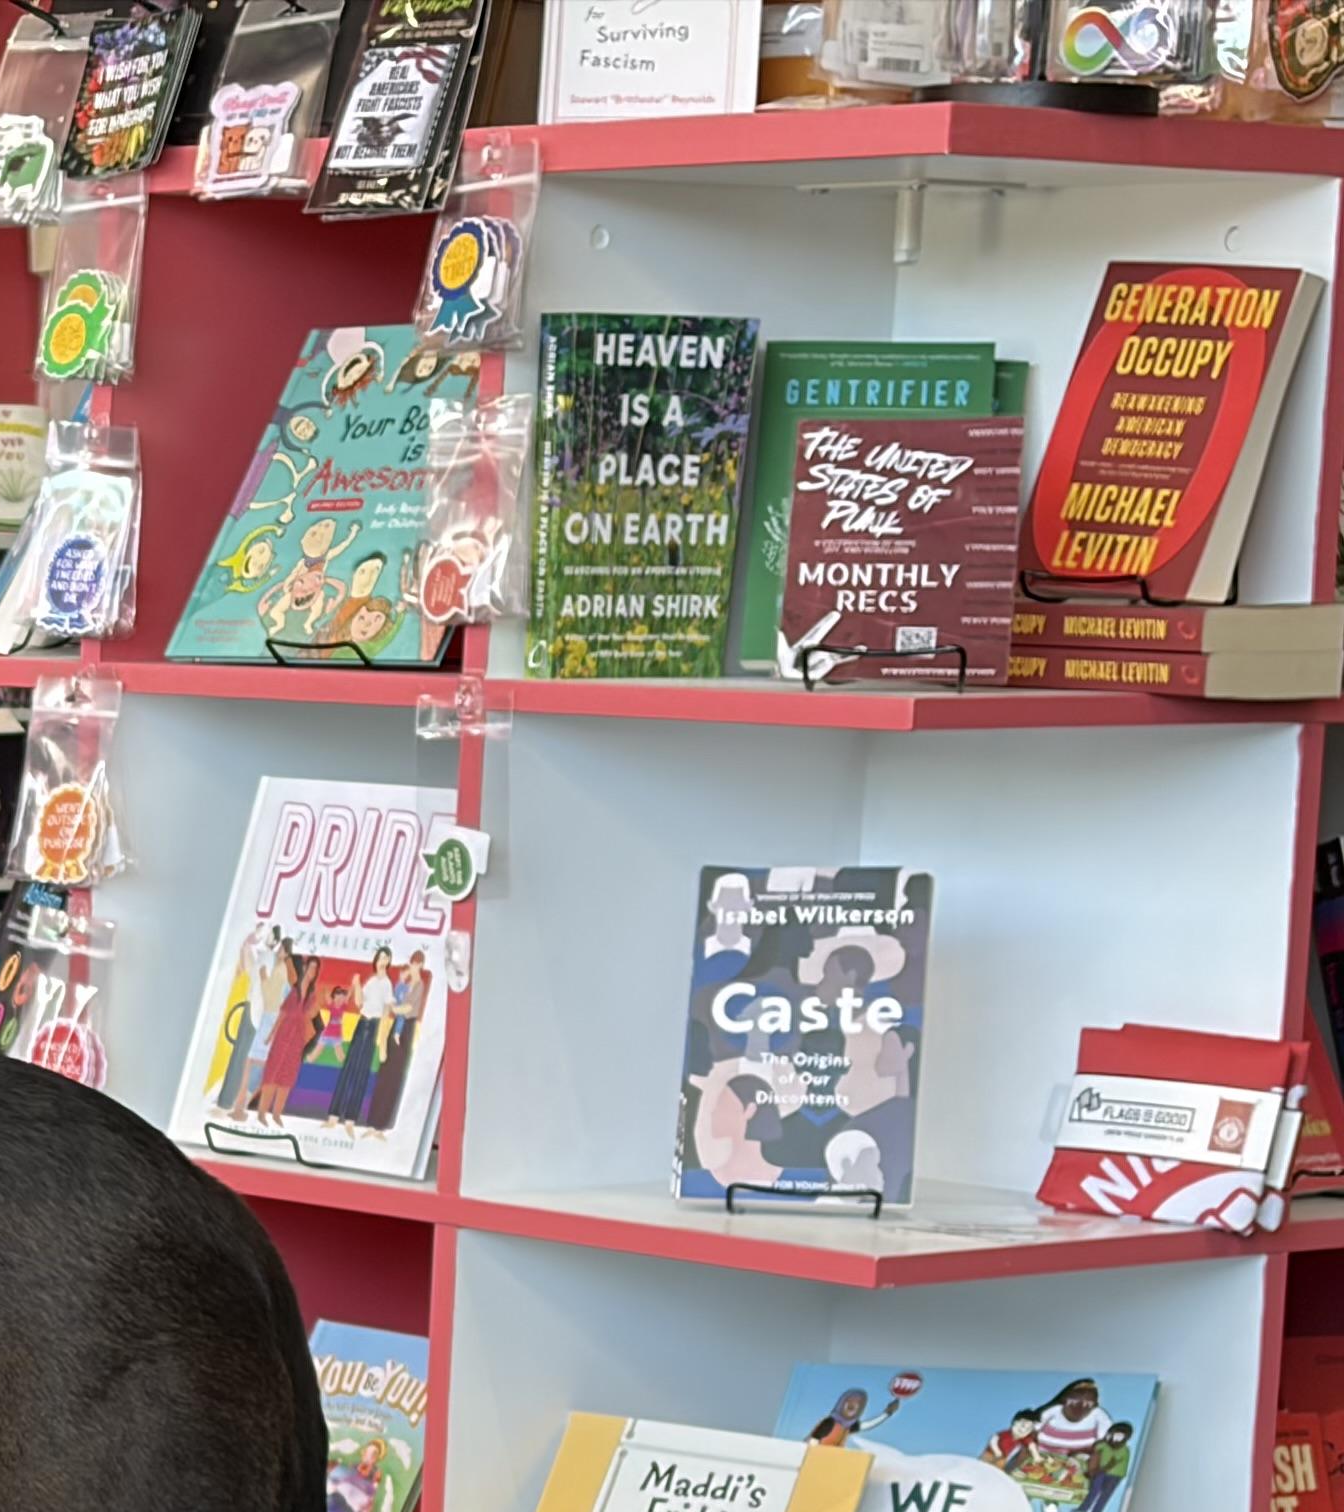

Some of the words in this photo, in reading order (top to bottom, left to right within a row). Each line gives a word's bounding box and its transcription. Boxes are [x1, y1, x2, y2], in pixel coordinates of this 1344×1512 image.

[584, 6, 606, 22] for
[597, 23, 690, 44] Surviving
[105, 60, 132, 82] WISH
[132, 55, 151, 74] FOR
[150, 48, 170, 69] YOU
[579, 50, 656, 73] Fascism
[94, 87, 121, 110] WHAT
[123, 82, 141, 103] YOU
[368, 81, 421, 97] AMERICANS
[354, 98, 382, 113] FIGHT
[1103, 282, 1283, 331] GENERATION
[594, 332, 726, 370] HEAVEN
[1115, 336, 1234, 380] OCCUPY
[785, 378, 972, 407] GENTRIFIER
[1110, 391, 1207, 416] REAWAKENING
[620, 393, 650, 426] IS
[661, 394, 685, 427] A
[339, 414, 389, 443] Your
[1113, 415, 1187, 438] AMERICAN
[401, 434, 426, 463] is
[802, 426, 864, 461] THE
[864, 442, 976, 485] UNITED
[1101, 439, 1185, 461] DEMOCRACY
[598, 454, 702, 487] PLACE
[796, 463, 910, 506] STATES
[908, 485, 953, 513] OF
[820, 499, 905, 540] PUNK
[1060, 481, 1183, 529] MICHAEL
[563, 511, 614, 546] ON
[623, 512, 731, 547] EARTH
[1051, 530, 1161, 576] LEVITIN
[797, 562, 962, 589] MONTHLY
[559, 593, 646, 619] ADRIAN
[651, 594, 721, 620] SHIRK
[835, 590, 919, 614] RECS
[1063, 615, 1117, 638] MICHAEL
[1118, 617, 1169, 641] LEVITIN
[1064, 658, 1119, 682] MICHAEL
[1120, 661, 1170, 684] LEVITIN
[255, 801, 459, 937] PRIDE
[716, 904, 788, 926] Isabel
[794, 904, 916, 927] Wilkerson
[710, 981, 904, 1036] Caste
[760, 1051, 790, 1067] The
[792, 1052, 852, 1072] Origins
[778, 1070, 796, 1085] of
[797, 1070, 832, 1086] Our
[754, 1089, 851, 1107] Discontents
[312, 1354, 364, 1398] YOU
[376, 1358, 429, 1430] YOU!
[638, 1459, 767, 1510] Maddi's
